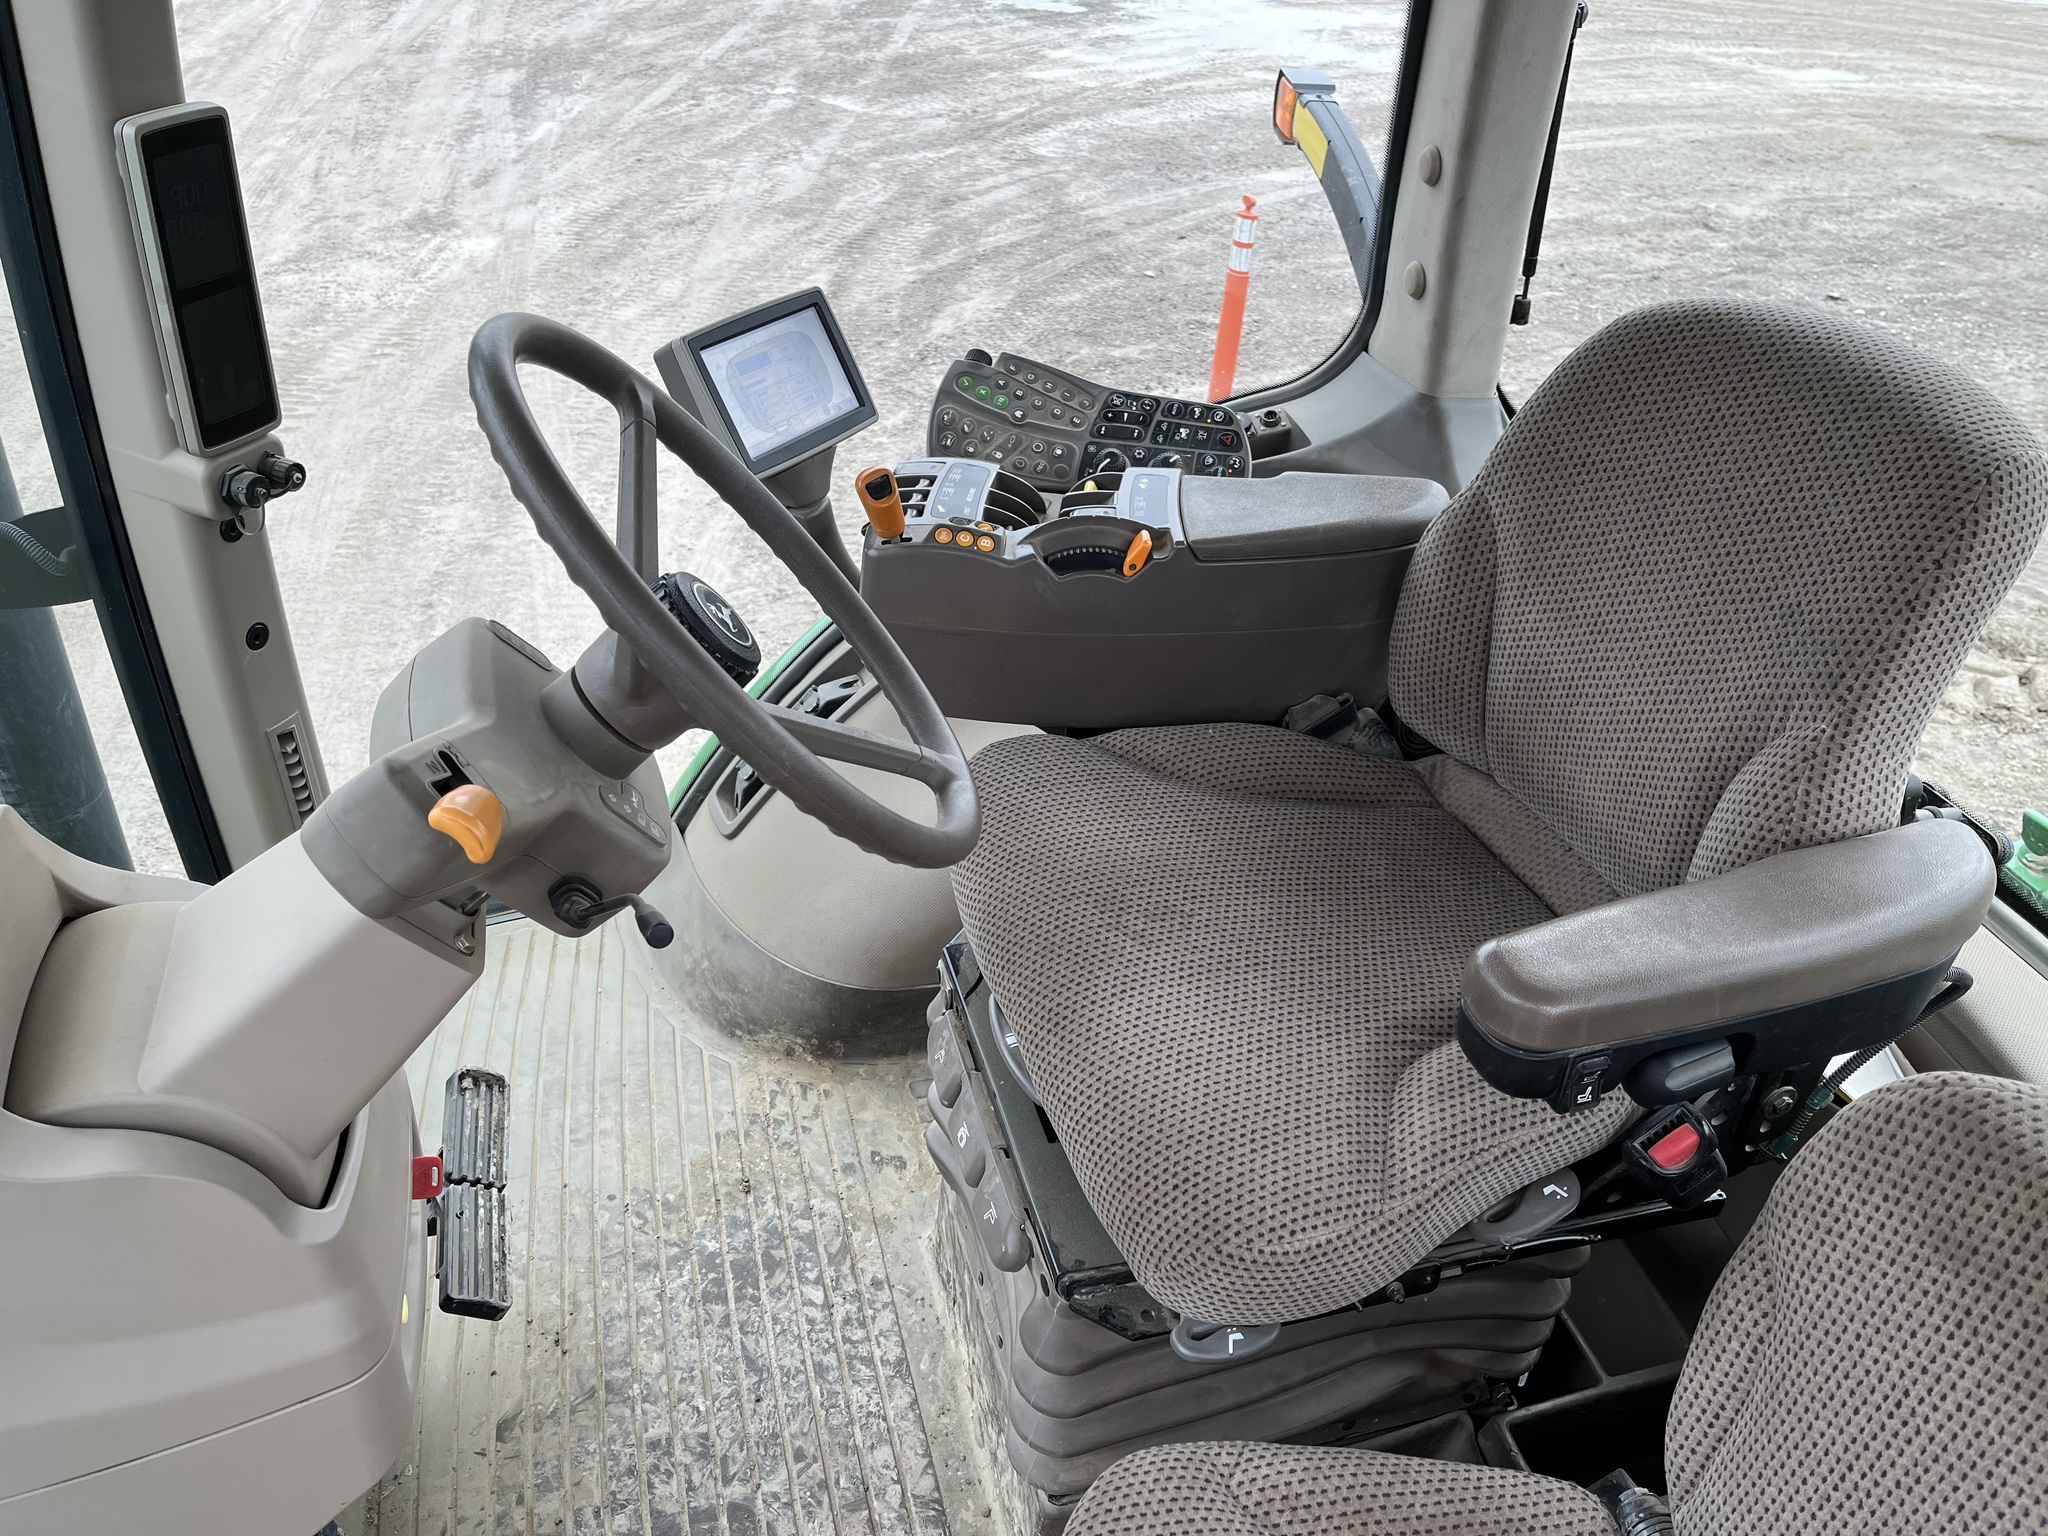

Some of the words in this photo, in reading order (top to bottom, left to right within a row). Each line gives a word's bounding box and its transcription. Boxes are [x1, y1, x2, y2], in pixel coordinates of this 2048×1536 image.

[1015, 389, 1024, 397] B
[1053, 407, 1062, 415] D
[1171, 403, 1179, 416] AUTO
[1072, 416, 1081, 424] E
[959, 534, 970, 542] C
[980, 538, 991, 548] B
[424, 759, 442, 774] N
